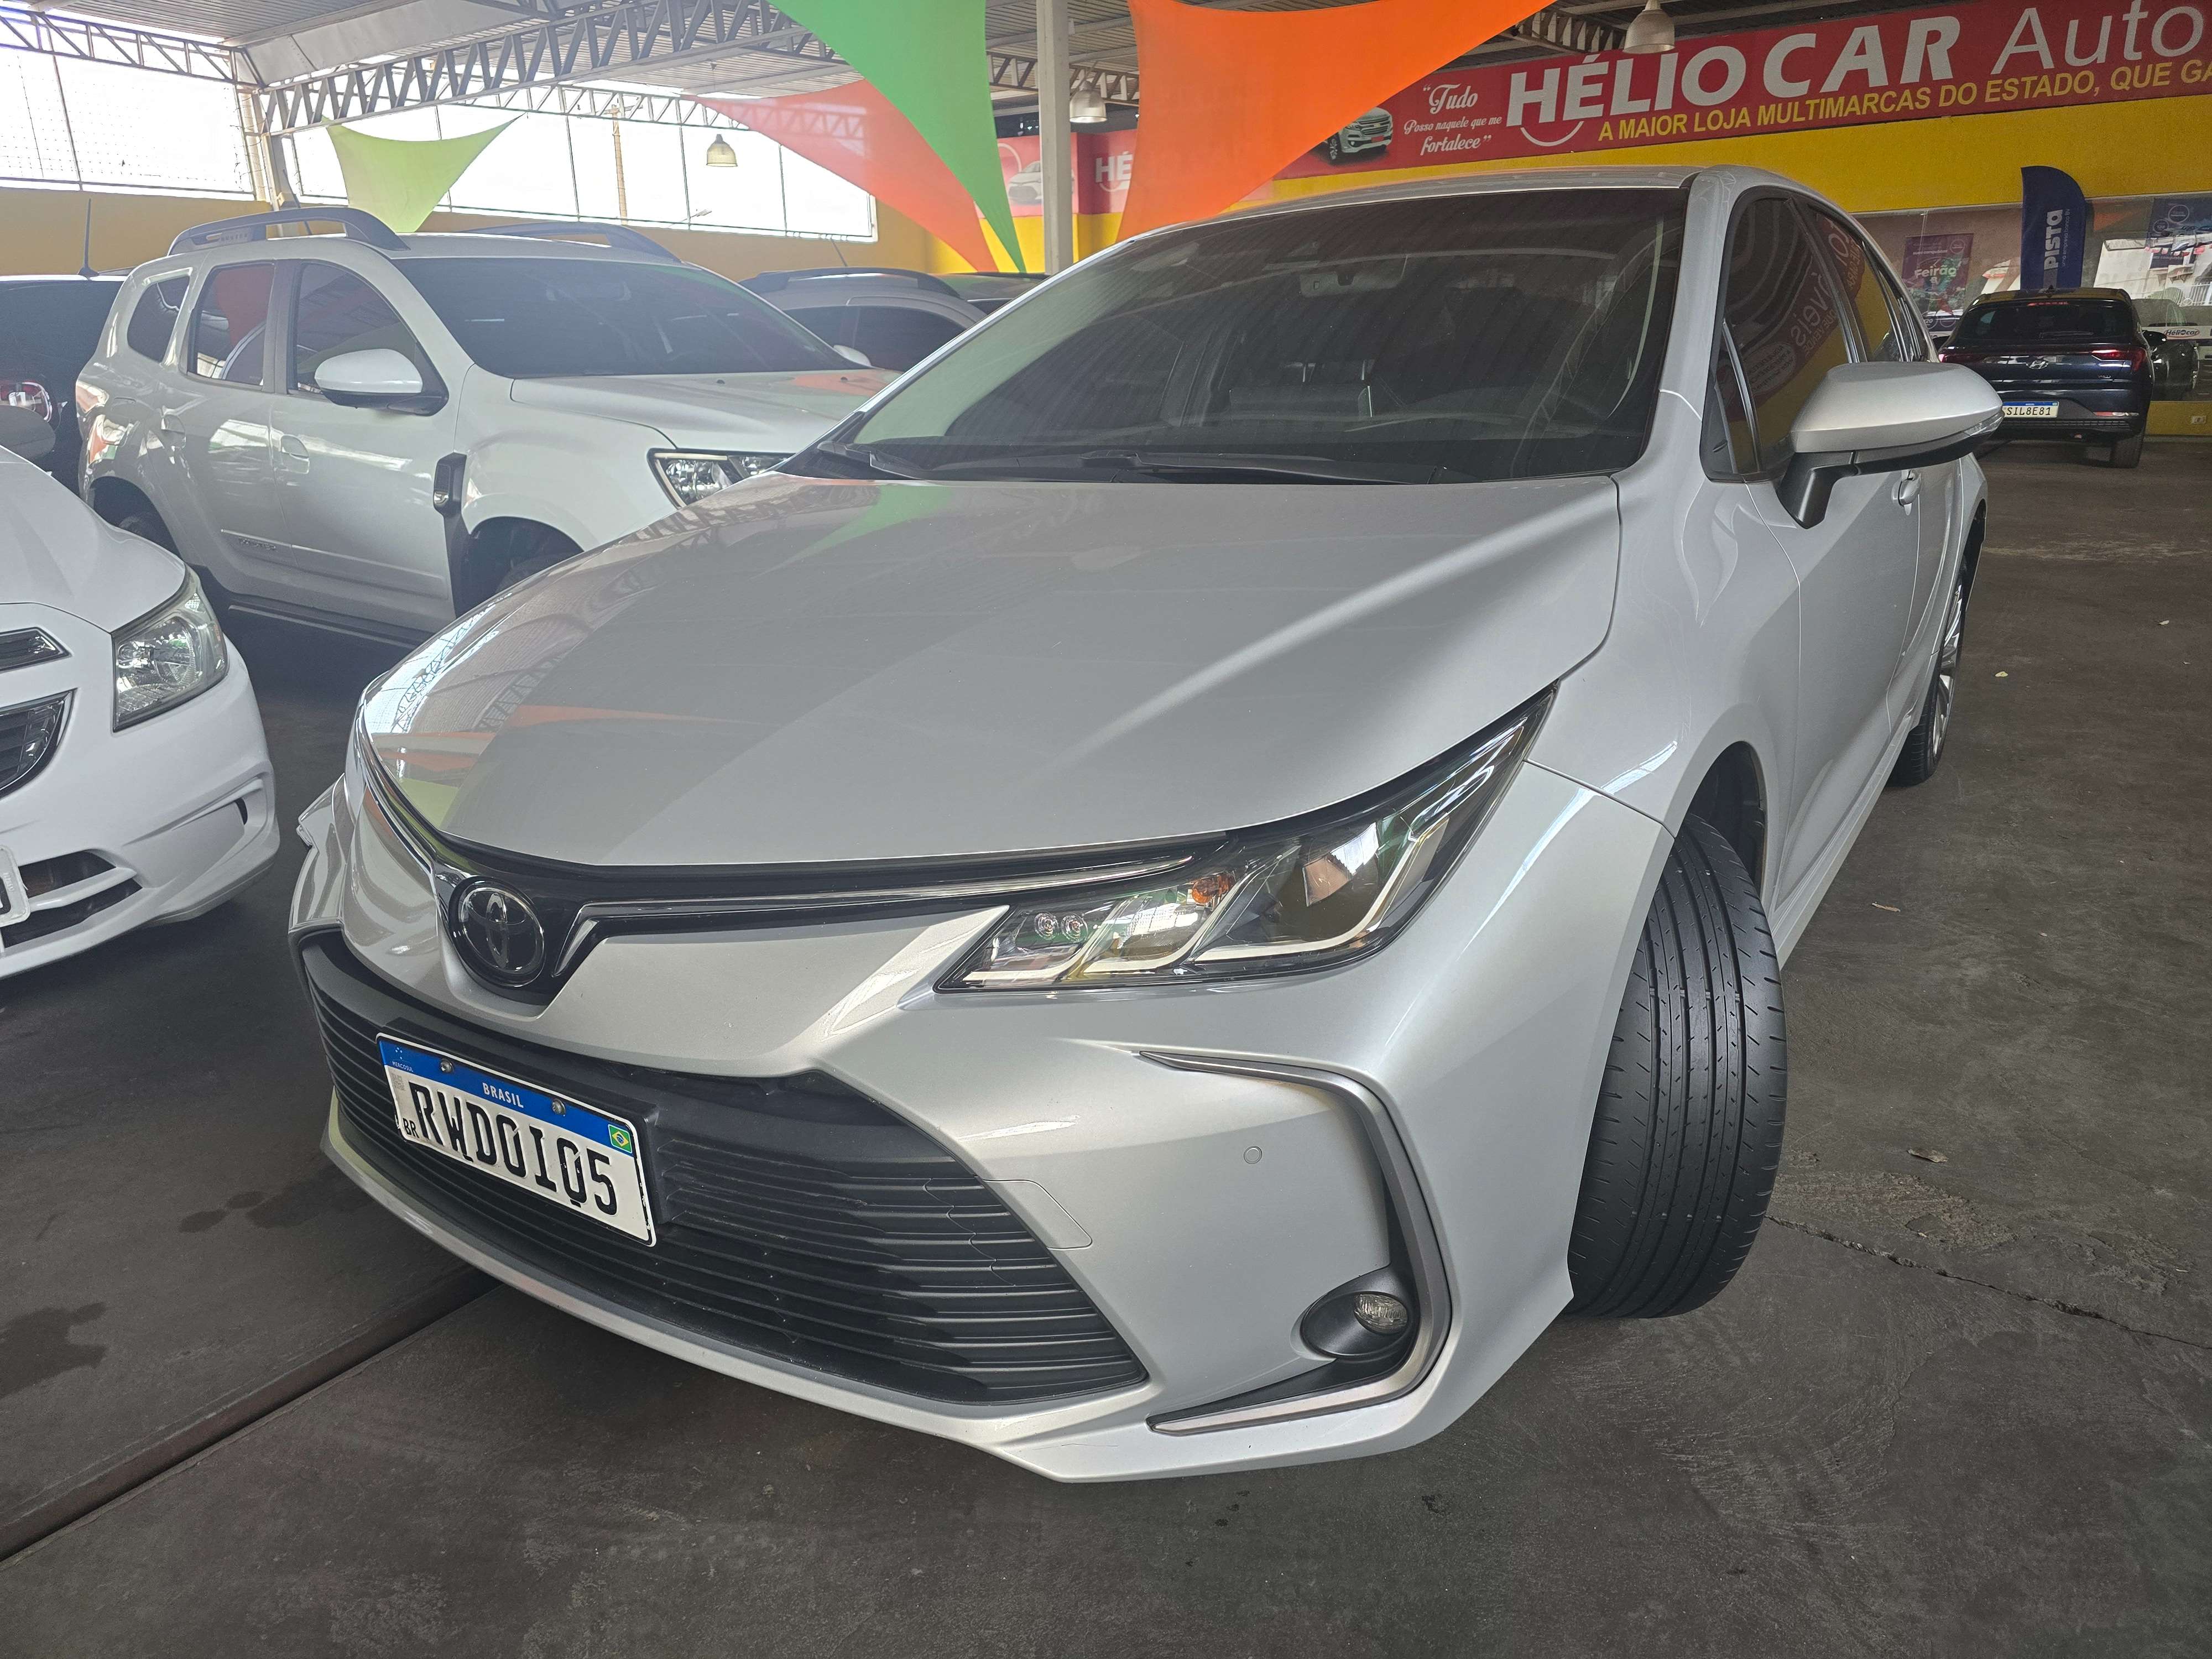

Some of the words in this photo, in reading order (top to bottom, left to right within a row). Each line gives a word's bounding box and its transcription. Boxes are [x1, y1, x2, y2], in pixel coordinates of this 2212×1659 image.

[1506, 45, 1746, 128] HÉLIO
[1762, 16, 1960, 98] CAR
[1991, 0, 2204, 75] Auto
[1598, 122, 1614, 142] A
[1618, 113, 1687, 139] MAIOR
[1694, 107, 1751, 132] LOJA
[1757, 87, 1930, 126] MULTIMARCAS
[1939, 82, 1978, 107] DO
[1985, 70, 2100, 103] ESTADO,
[2110, 62, 2171, 90] QUE
[2180, 59, 2212, 84] GA
[1404, 119, 1433, 134] Posso
[1435, 116, 1469, 132] naquele
[1470, 117, 1486, 129] que
[1488, 116, 1503, 126] me
[2006, 407, 2051, 415] SIL8E81
[392, 1061, 414, 1072] MERCOSUL
[482, 1082, 524, 1109] BRASIL
[401, 1117, 419, 1139] BR
